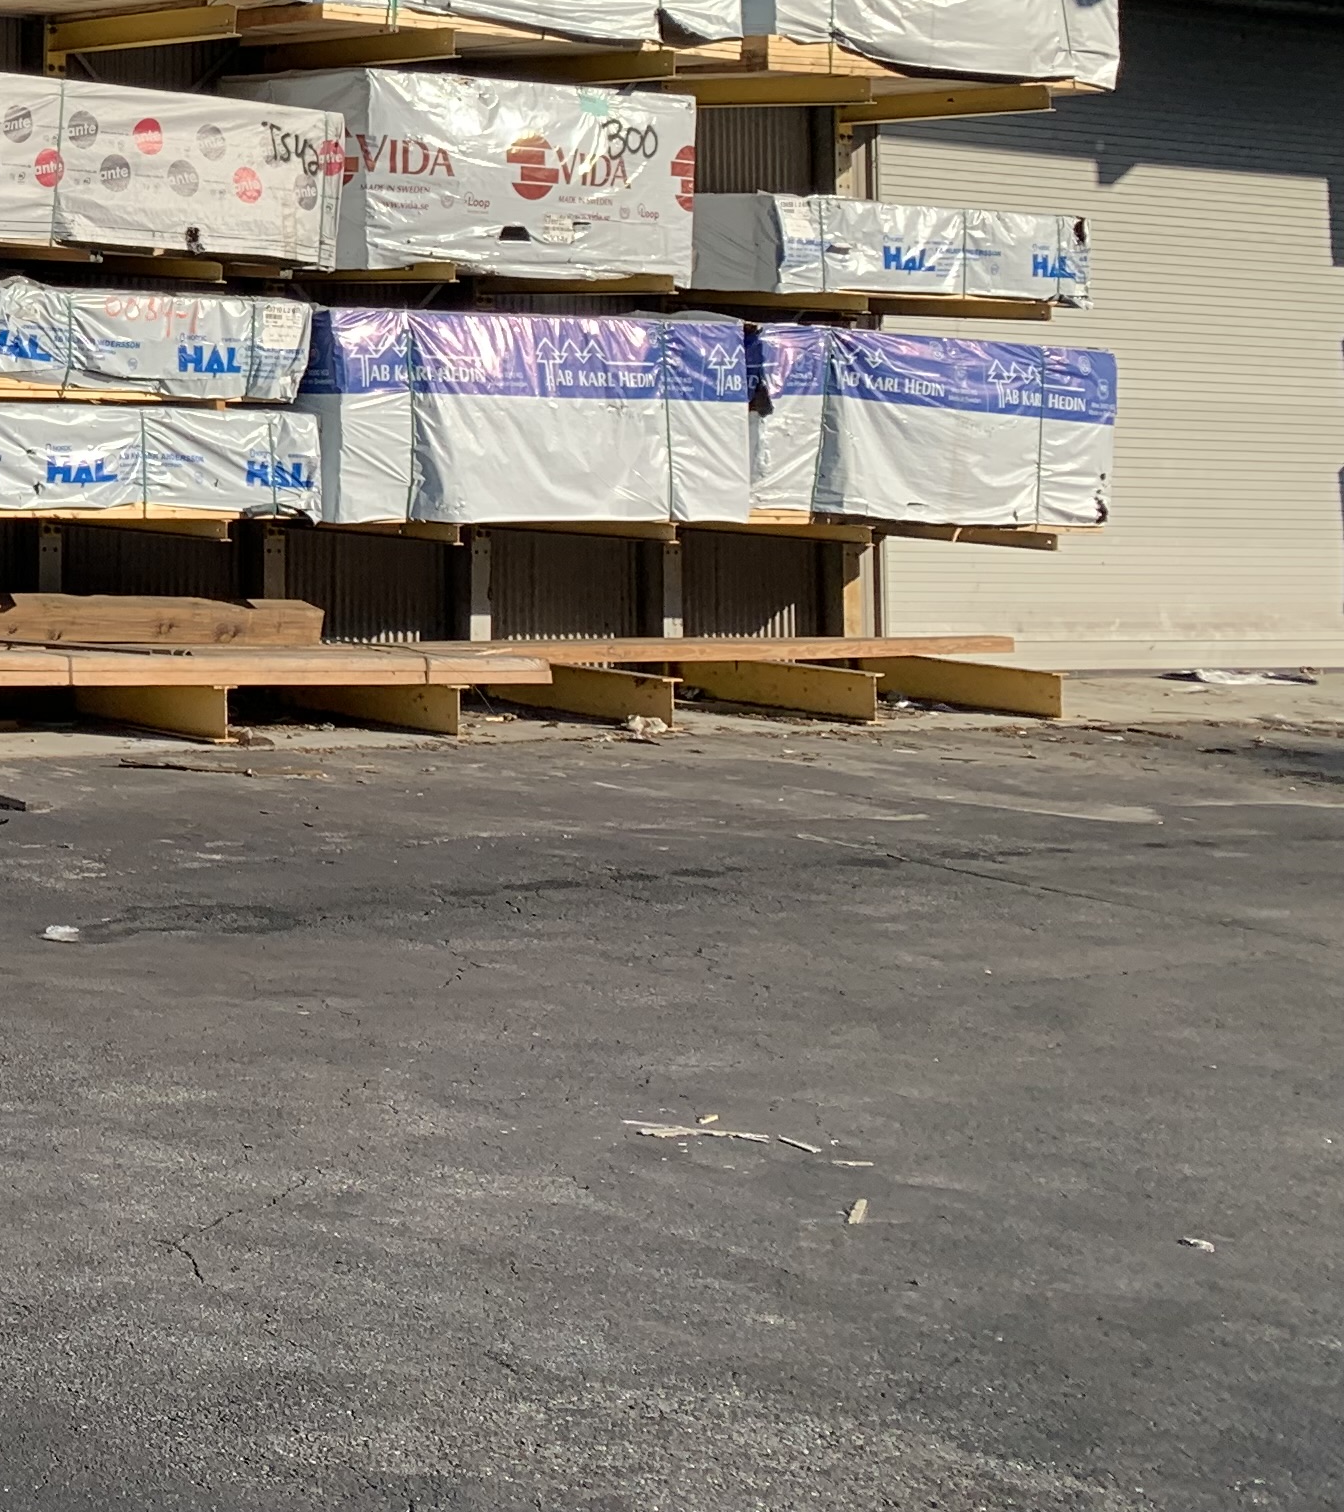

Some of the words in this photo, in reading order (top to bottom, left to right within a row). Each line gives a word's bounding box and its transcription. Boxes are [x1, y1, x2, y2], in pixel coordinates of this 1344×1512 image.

[2, 118, 31, 133] ante
[67, 122, 97, 138] ante
[602, 118, 659, 160] 300
[356, 133, 455, 177] VIDA
[99, 164, 129, 180] ante
[554, 145, 632, 190] VIDA
[167, 172, 197, 186] ante
[397, 185, 431, 194] SWEDEN
[467, 194, 491, 209] Loop
[640, 206, 660, 219] Loop
[883, 245, 936, 274] HAL
[178, 344, 242, 377] HAL
[370, 365, 390, 382] AB
[555, 370, 574, 387] AB
[578, 371, 616, 387] KARL
[619, 371, 657, 389] HEDIN
[725, 376, 742, 392] AB
[843, 370, 862, 388] AB
[864, 373, 901, 394] KARL
[904, 377, 946, 398] HEDIN
[1005, 388, 1019, 405] AB
[1048, 393, 1087, 412] HEDIN
[46, 455, 118, 485] HAL
[245, 459, 315, 489] HAL
